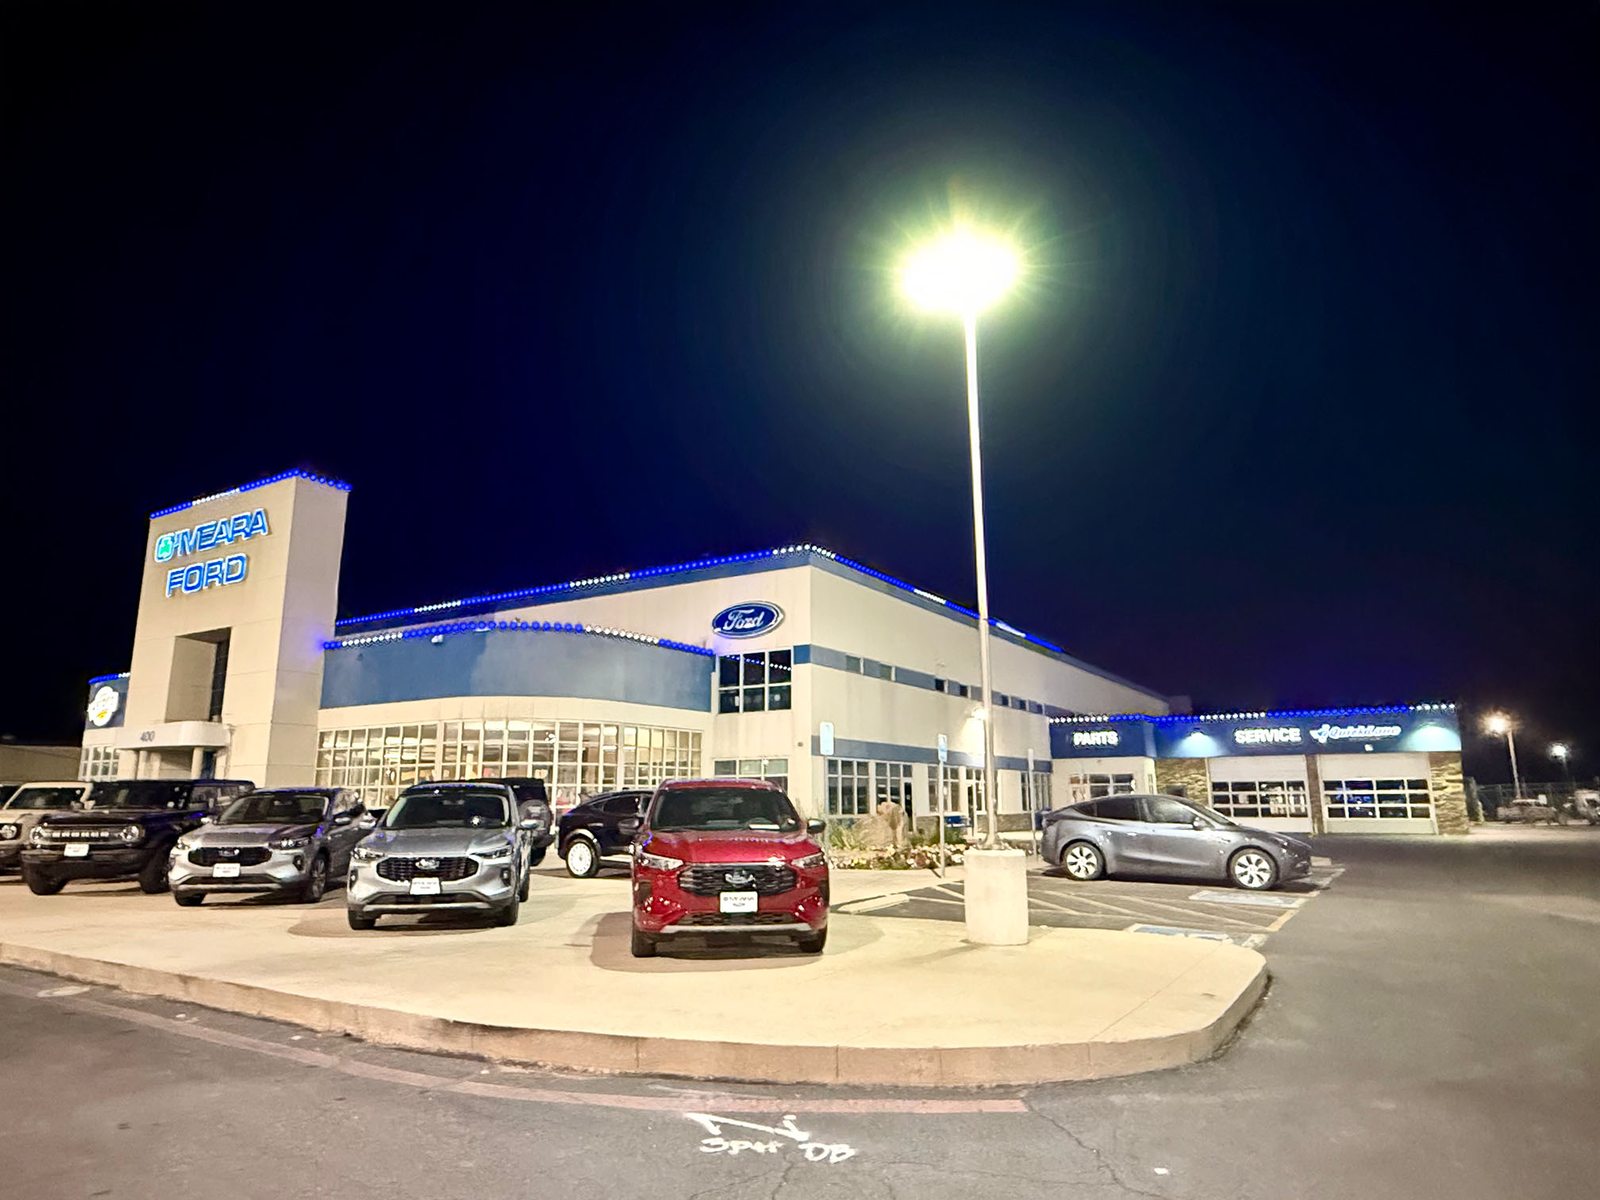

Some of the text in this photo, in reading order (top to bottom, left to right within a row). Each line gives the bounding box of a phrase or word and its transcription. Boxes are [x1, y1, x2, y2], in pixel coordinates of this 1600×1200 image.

[166, 553, 247, 597] FORD
[722, 608, 765, 630] Ford
[1073, 731, 1119, 746] PARTS
[1234, 727, 1302, 744] SERVICE
